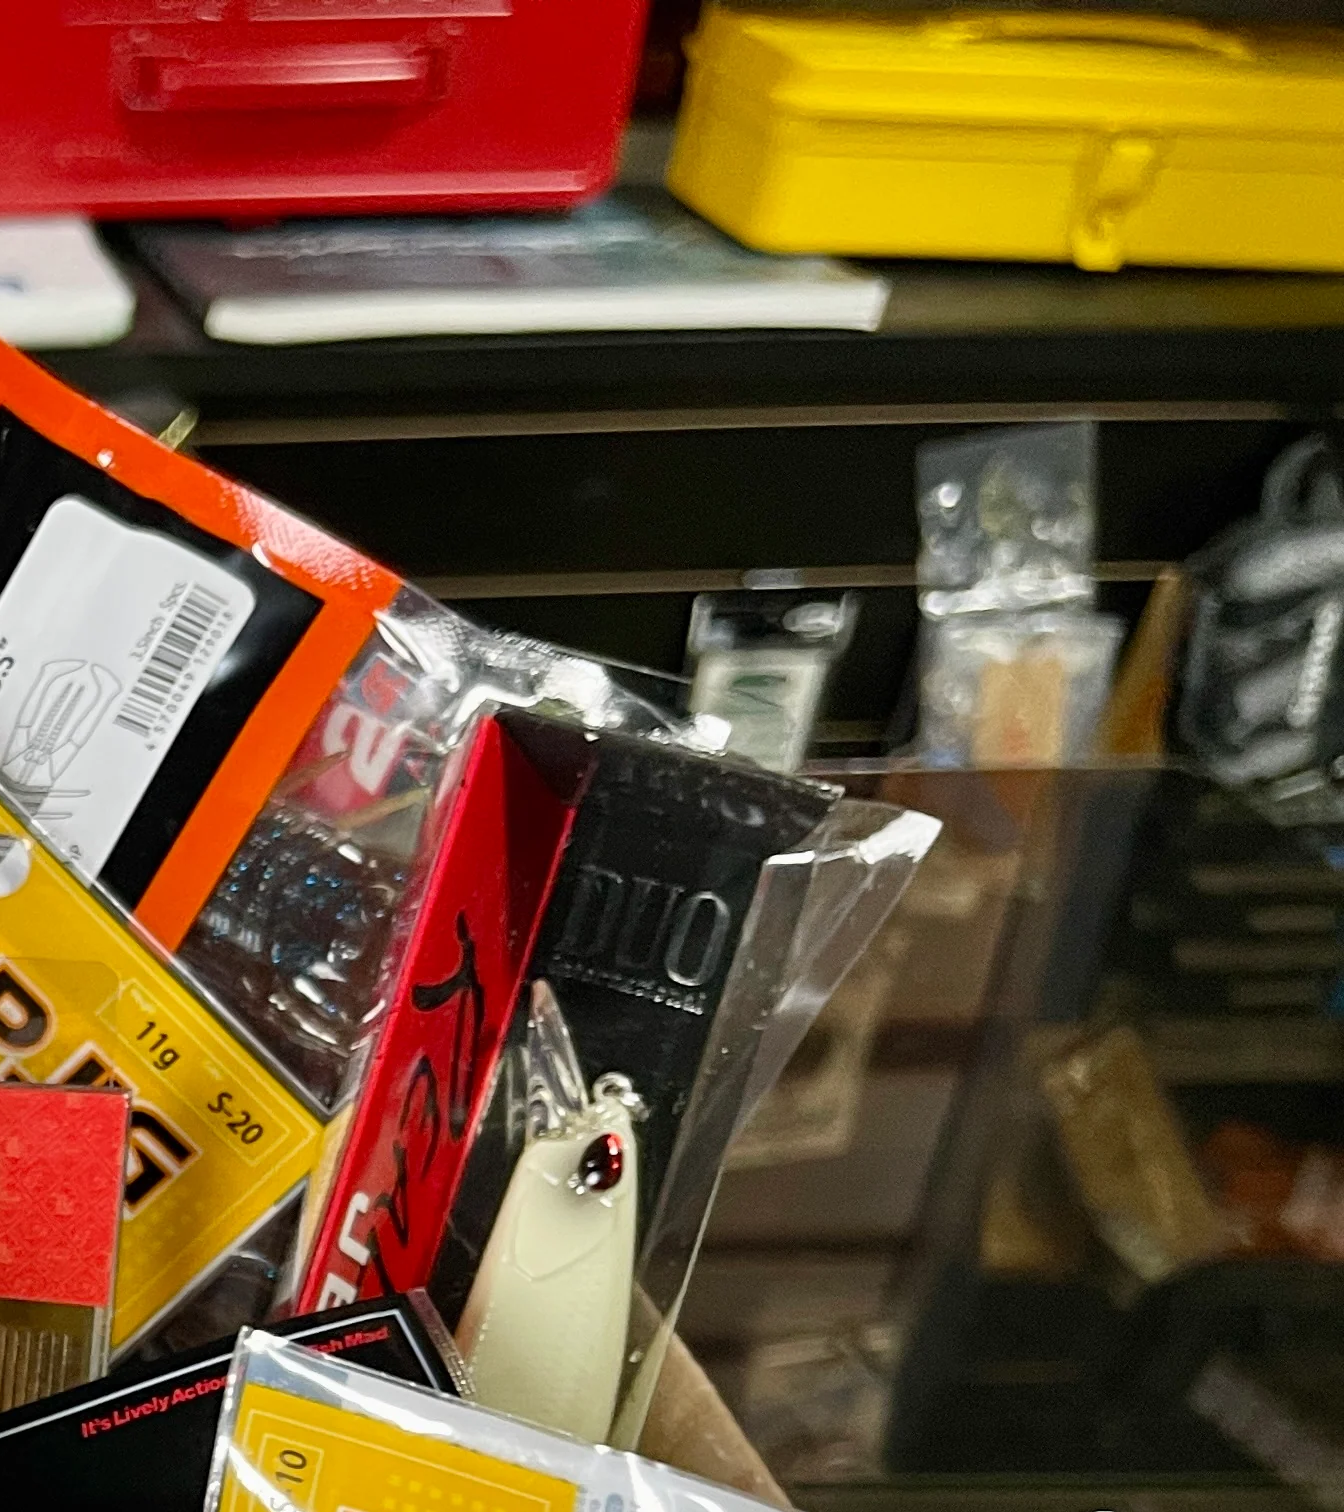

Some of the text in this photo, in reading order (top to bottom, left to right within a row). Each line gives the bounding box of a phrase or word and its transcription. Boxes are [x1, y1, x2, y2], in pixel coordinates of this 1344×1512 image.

[132, 1018, 269, 1147] 11g S-20
[80, 1416, 112, 1439] It's
[113, 1396, 168, 1427] Lively
